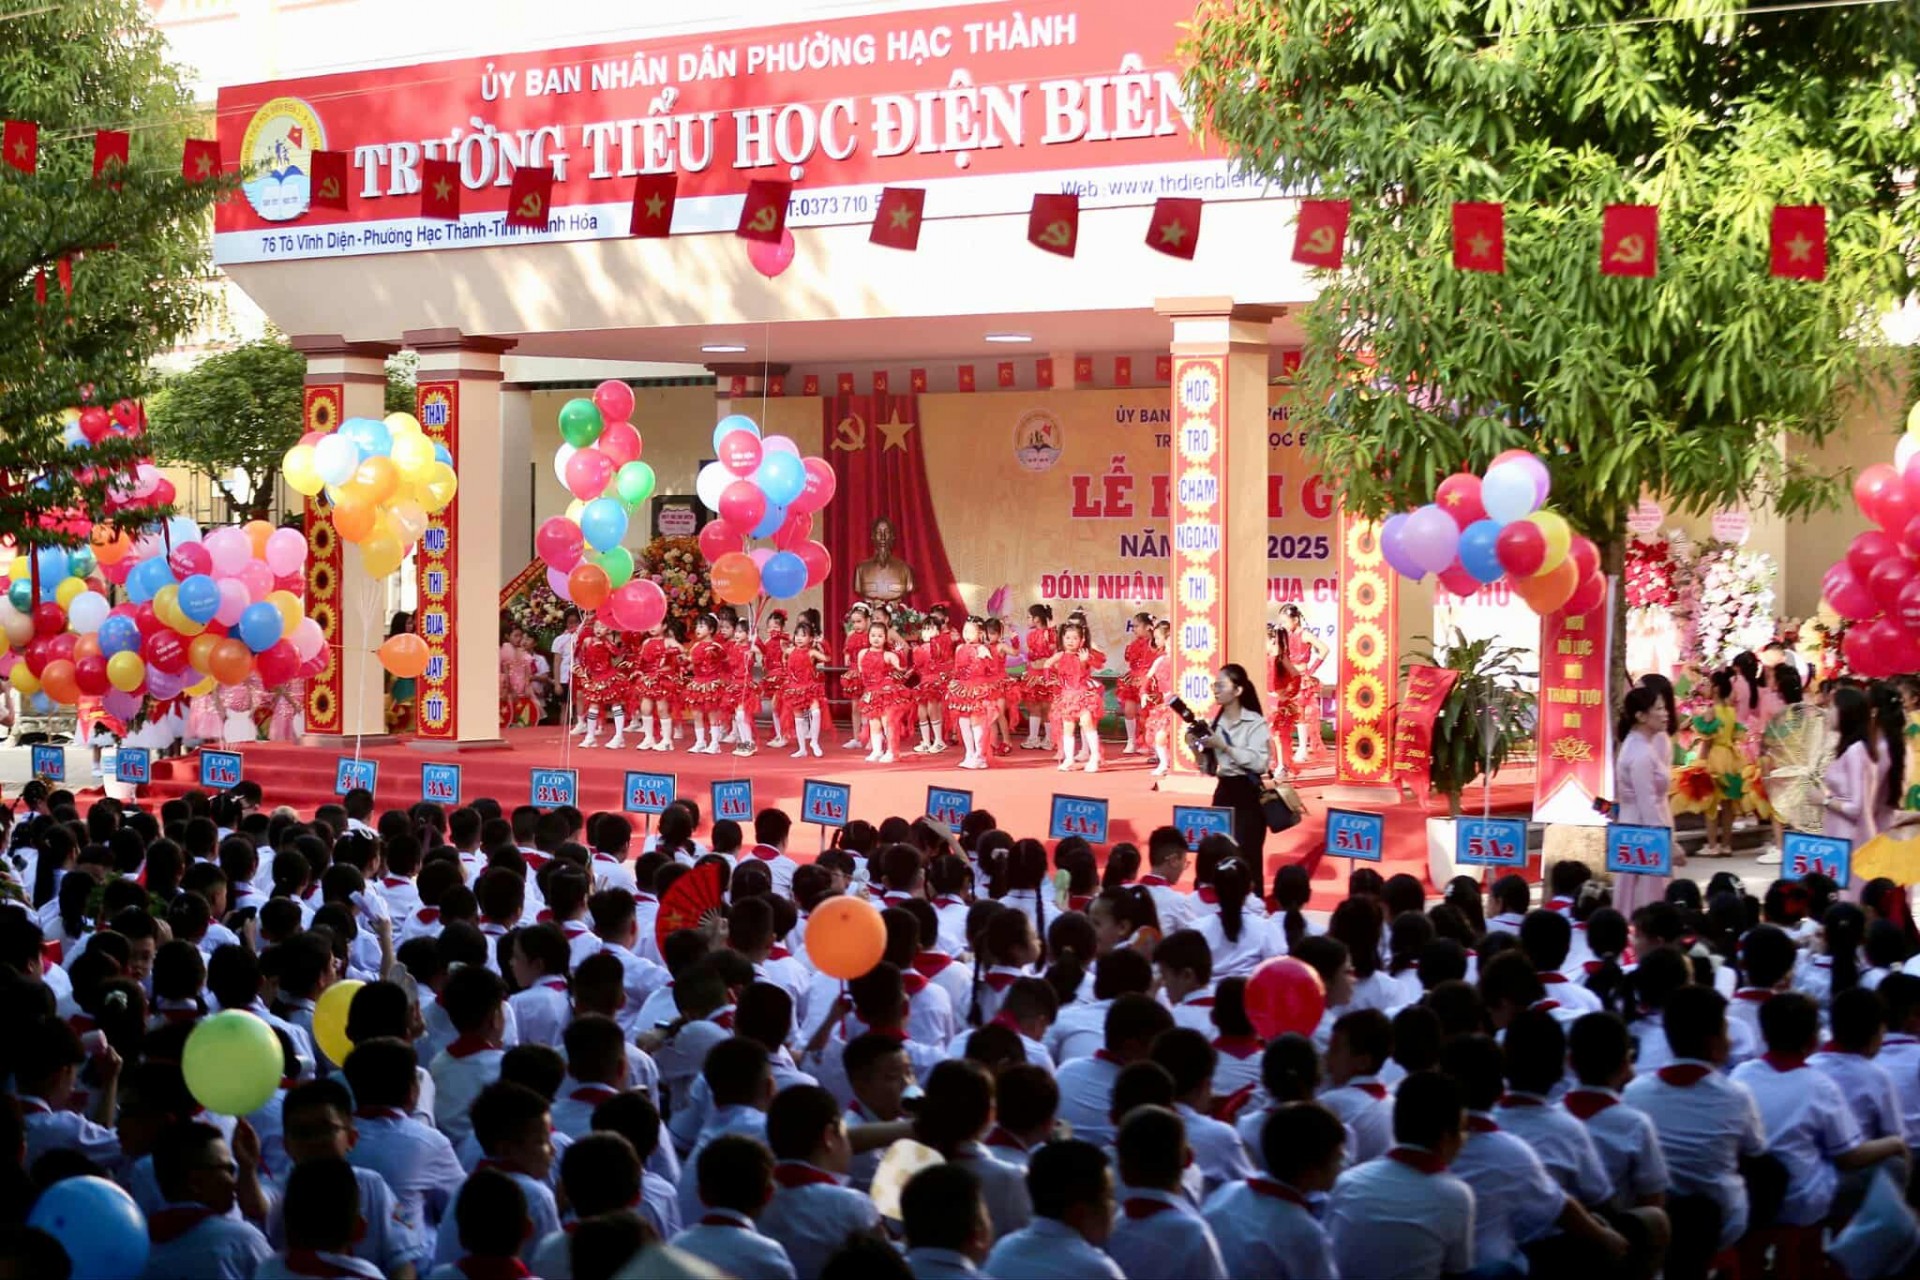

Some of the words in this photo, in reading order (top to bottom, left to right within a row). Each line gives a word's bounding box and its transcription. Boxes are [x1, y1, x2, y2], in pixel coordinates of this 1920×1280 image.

[481, 62, 517, 101] ỦY
[525, 67, 581, 96] BAN
[591, 51, 668, 91] NHÂN
[678, 43, 737, 82] DÂN
[747, 31, 876, 75] PHƯỜNG
[887, 26, 952, 65] HẠC
[963, 12, 1077, 54] THÀNH
[582, 86, 719, 180] TIỂU
[732, 98, 858, 181] HỌC
[870, 68, 1030, 169] ĐIỆN
[1039, 52, 1197, 145] BIÊN
[842, 196, 868, 213] 710
[262, 237, 276, 253] 76
[327, 230, 356, 251] Diện
[416, 225, 442, 246] Hạc
[445, 221, 486, 240] Thành
[570, 213, 598, 230] Hóa
[1116, 405, 1138, 423] ỦY
[1140, 410, 1171, 423] BAN
[1269, 432, 1293, 451] ỌC
[1072, 455, 1134, 518] LỄ
[1177, 526, 1218, 549] NGOAN
[1268, 535, 1329, 560] 2025
[428, 573, 442, 593] THI
[1041, 570, 1090, 599] ĐÓN
[1098, 570, 1164, 605] NHẬN
[1268, 577, 1305, 603] UA
[1188, 577, 1207, 600] THI
[426, 614, 444, 635] ĐUA
[1185, 626, 1209, 649] ĐUA
[209, 767, 235, 783] 1A6
[427, 781, 453, 797] 3A2
[538, 786, 569, 802] 3A3
[633, 789, 667, 807] 3A4
[721, 798, 748, 815] 4A1
[812, 799, 842, 818] 4A2
[1336, 830, 1372, 851] 5A1
[1468, 838, 1514, 859] 5A2
[1616, 845, 1660, 867] 5A3
